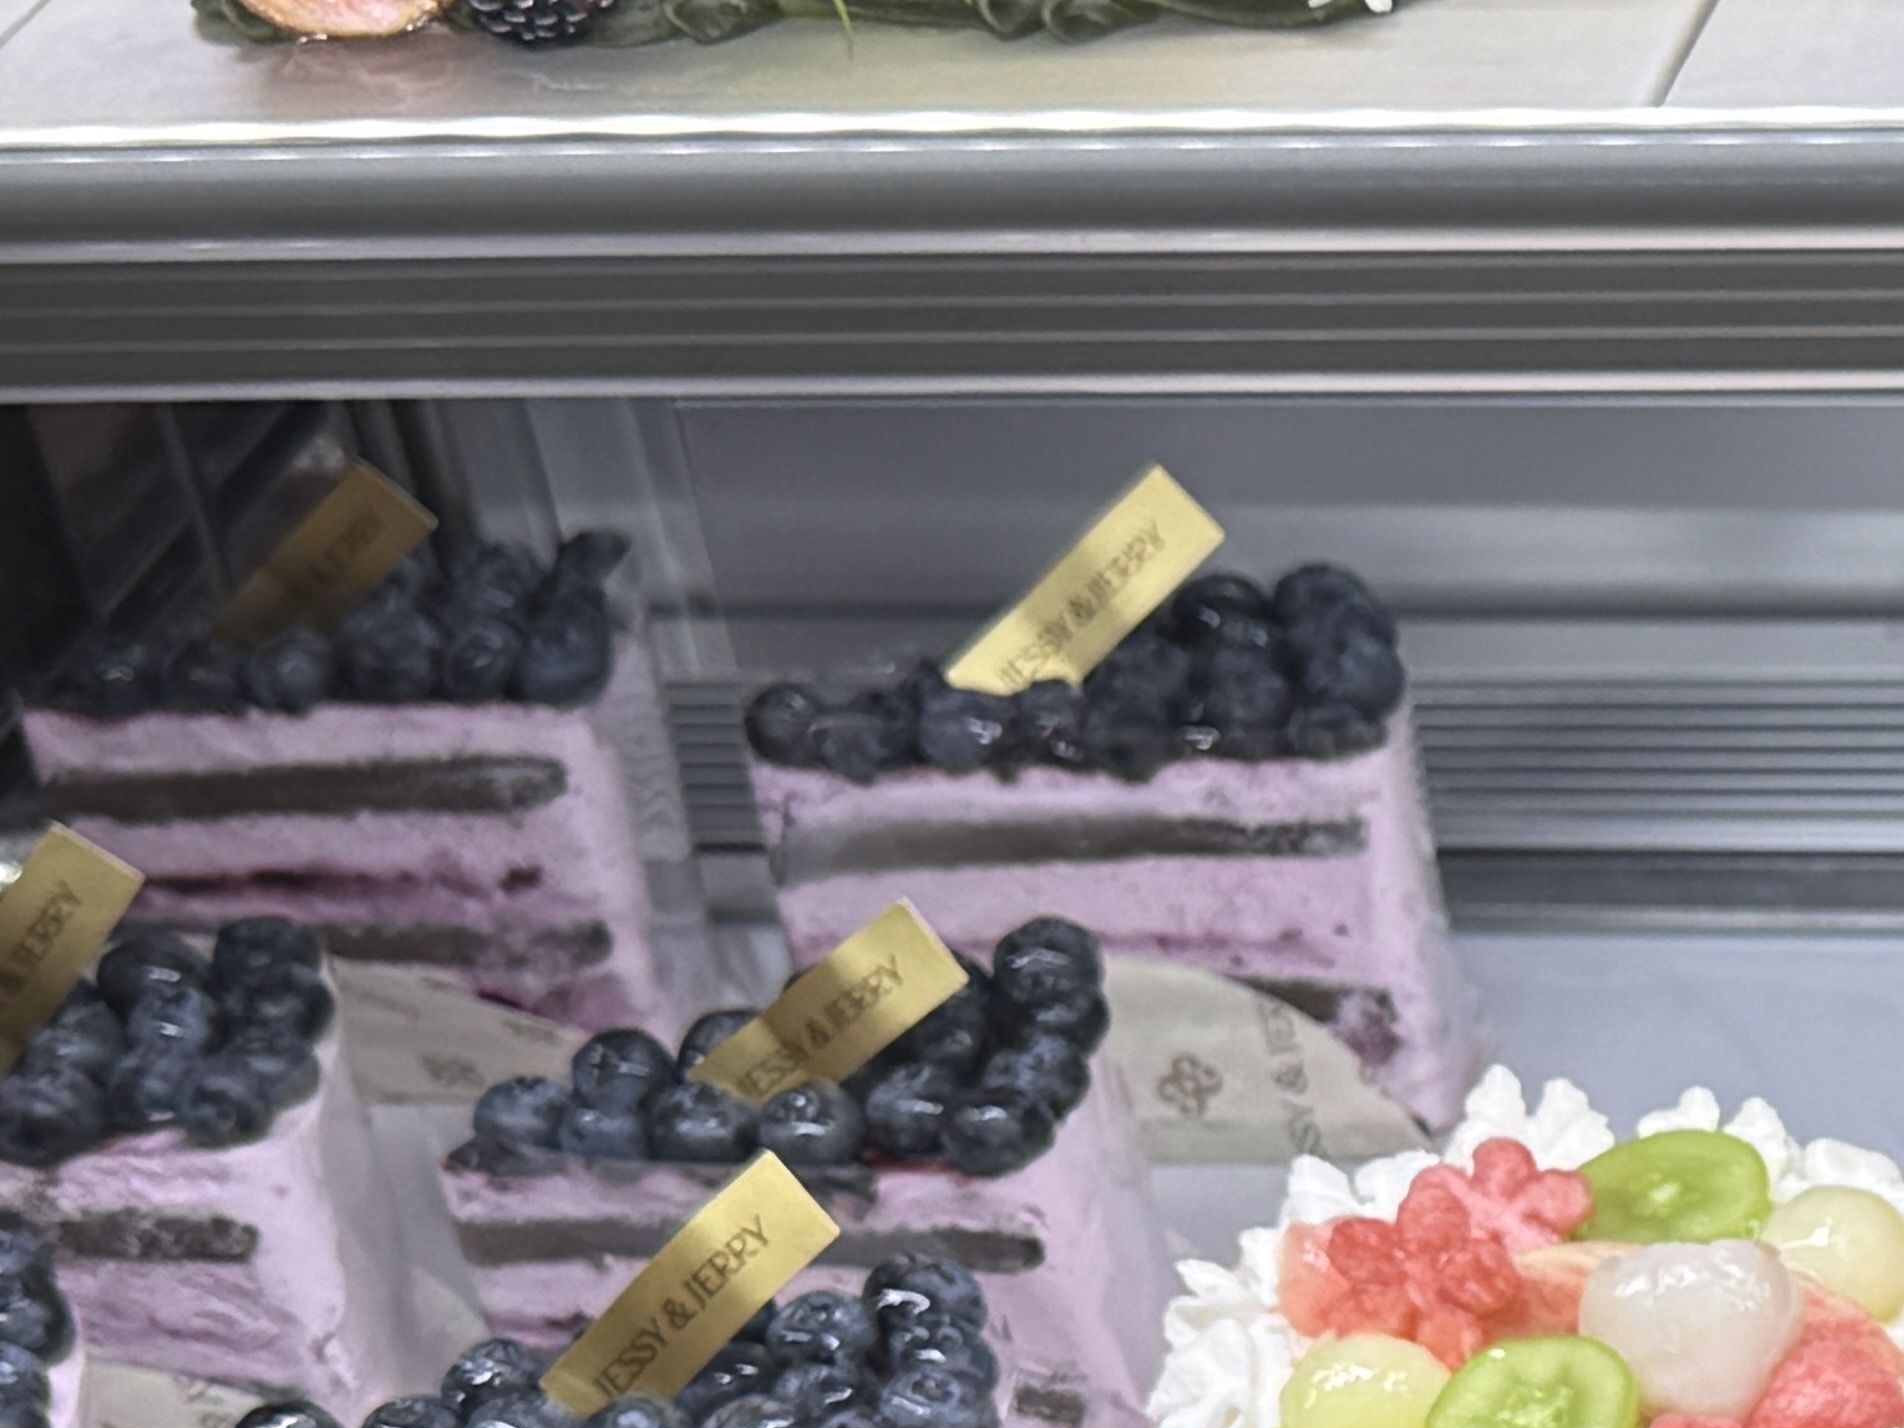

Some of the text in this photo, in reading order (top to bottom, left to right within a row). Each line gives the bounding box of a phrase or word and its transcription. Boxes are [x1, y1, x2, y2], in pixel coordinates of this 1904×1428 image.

[823, 953, 903, 1034] JERRY
[593, 1213, 769, 1400] JESSY & JERRY
